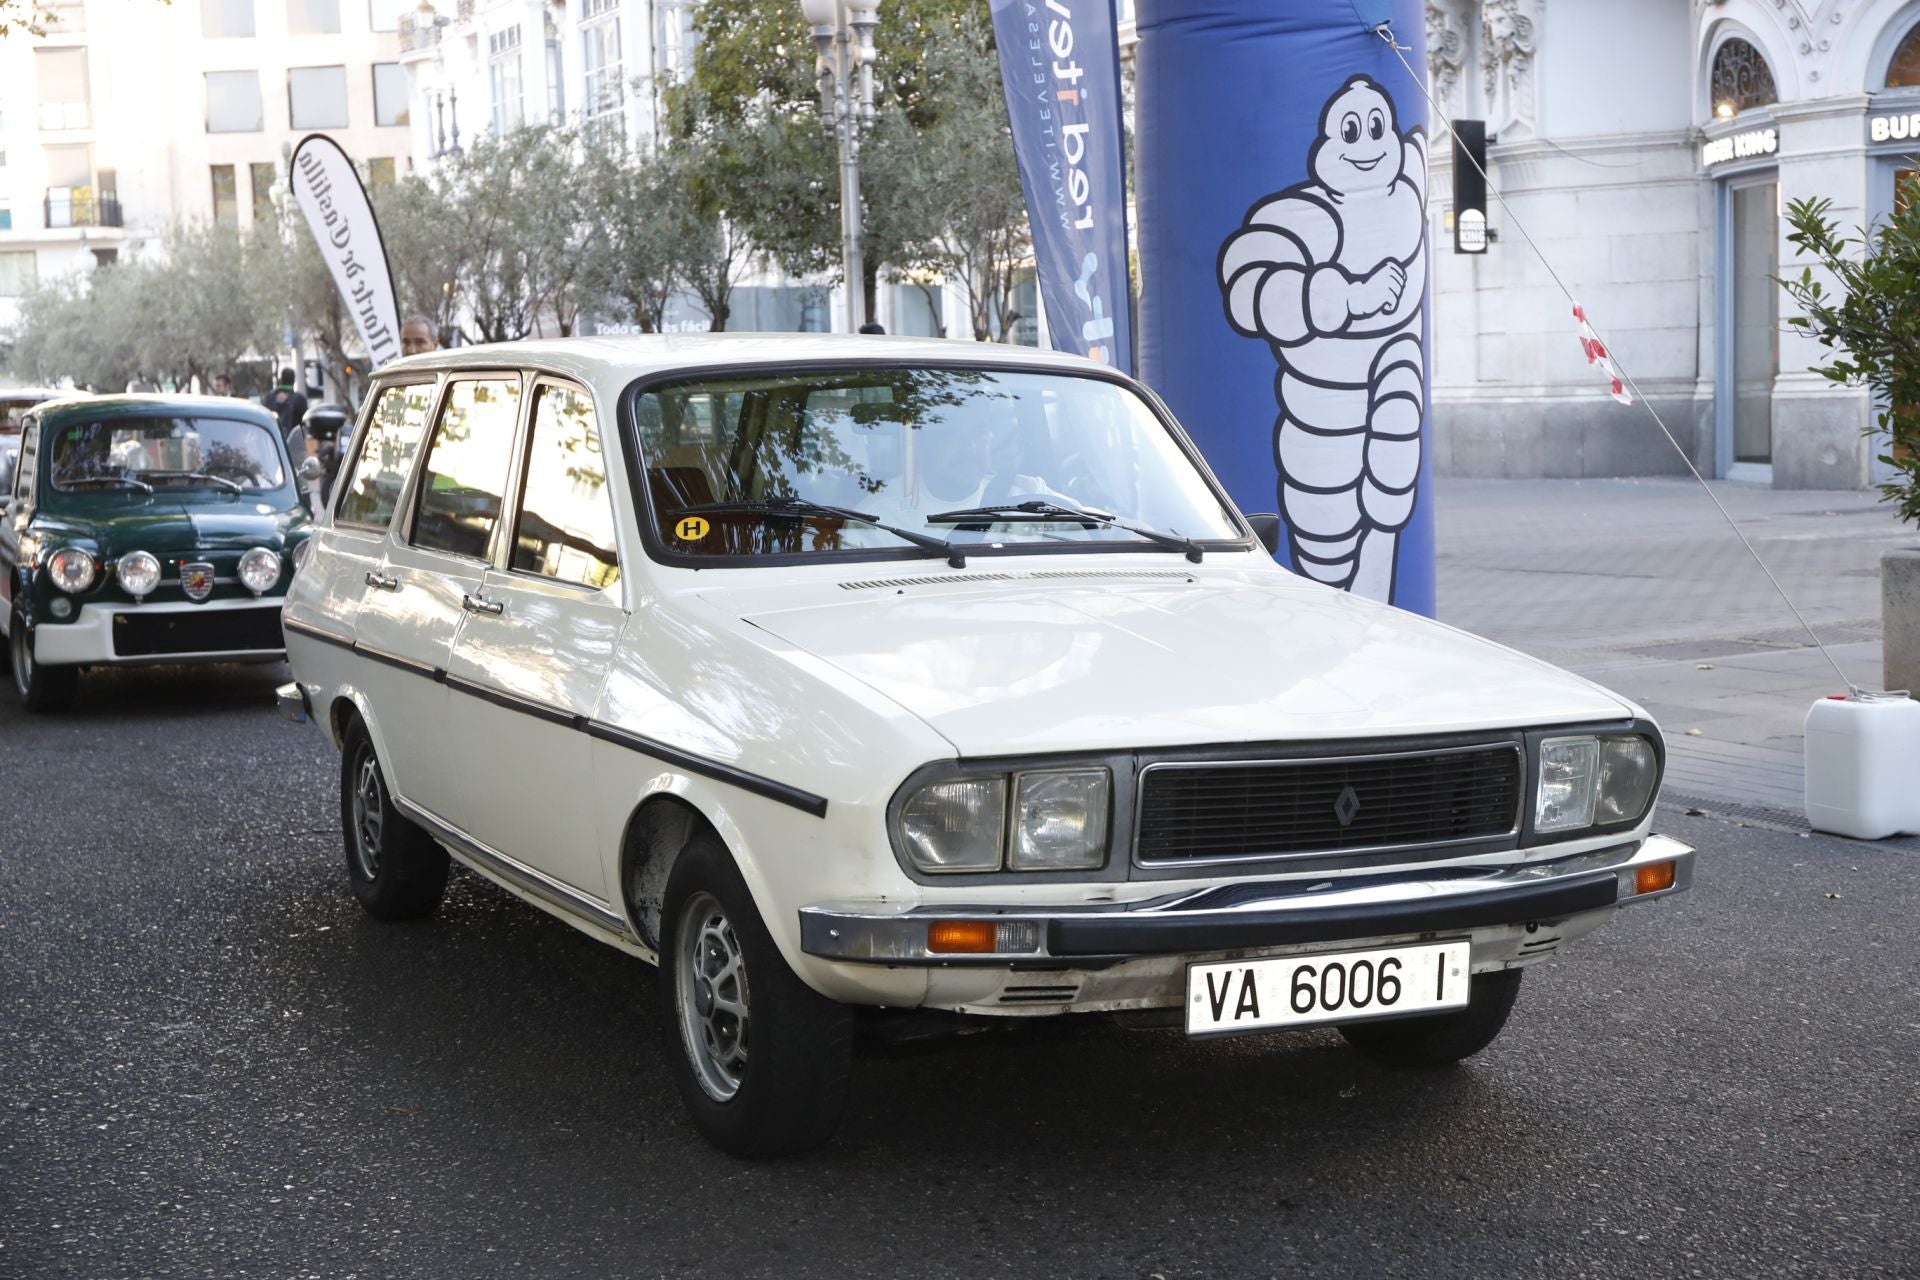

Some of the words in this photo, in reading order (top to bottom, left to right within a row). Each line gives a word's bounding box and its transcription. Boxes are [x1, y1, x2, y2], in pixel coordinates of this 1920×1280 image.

[1734, 129, 1777, 158] KING
[1460, 230, 1486, 243] KING
[595, 321, 629, 335] Todo
[683, 521, 701, 537] H
[1206, 968, 1260, 1022] VA
[1290, 957, 1402, 1014] 6006
